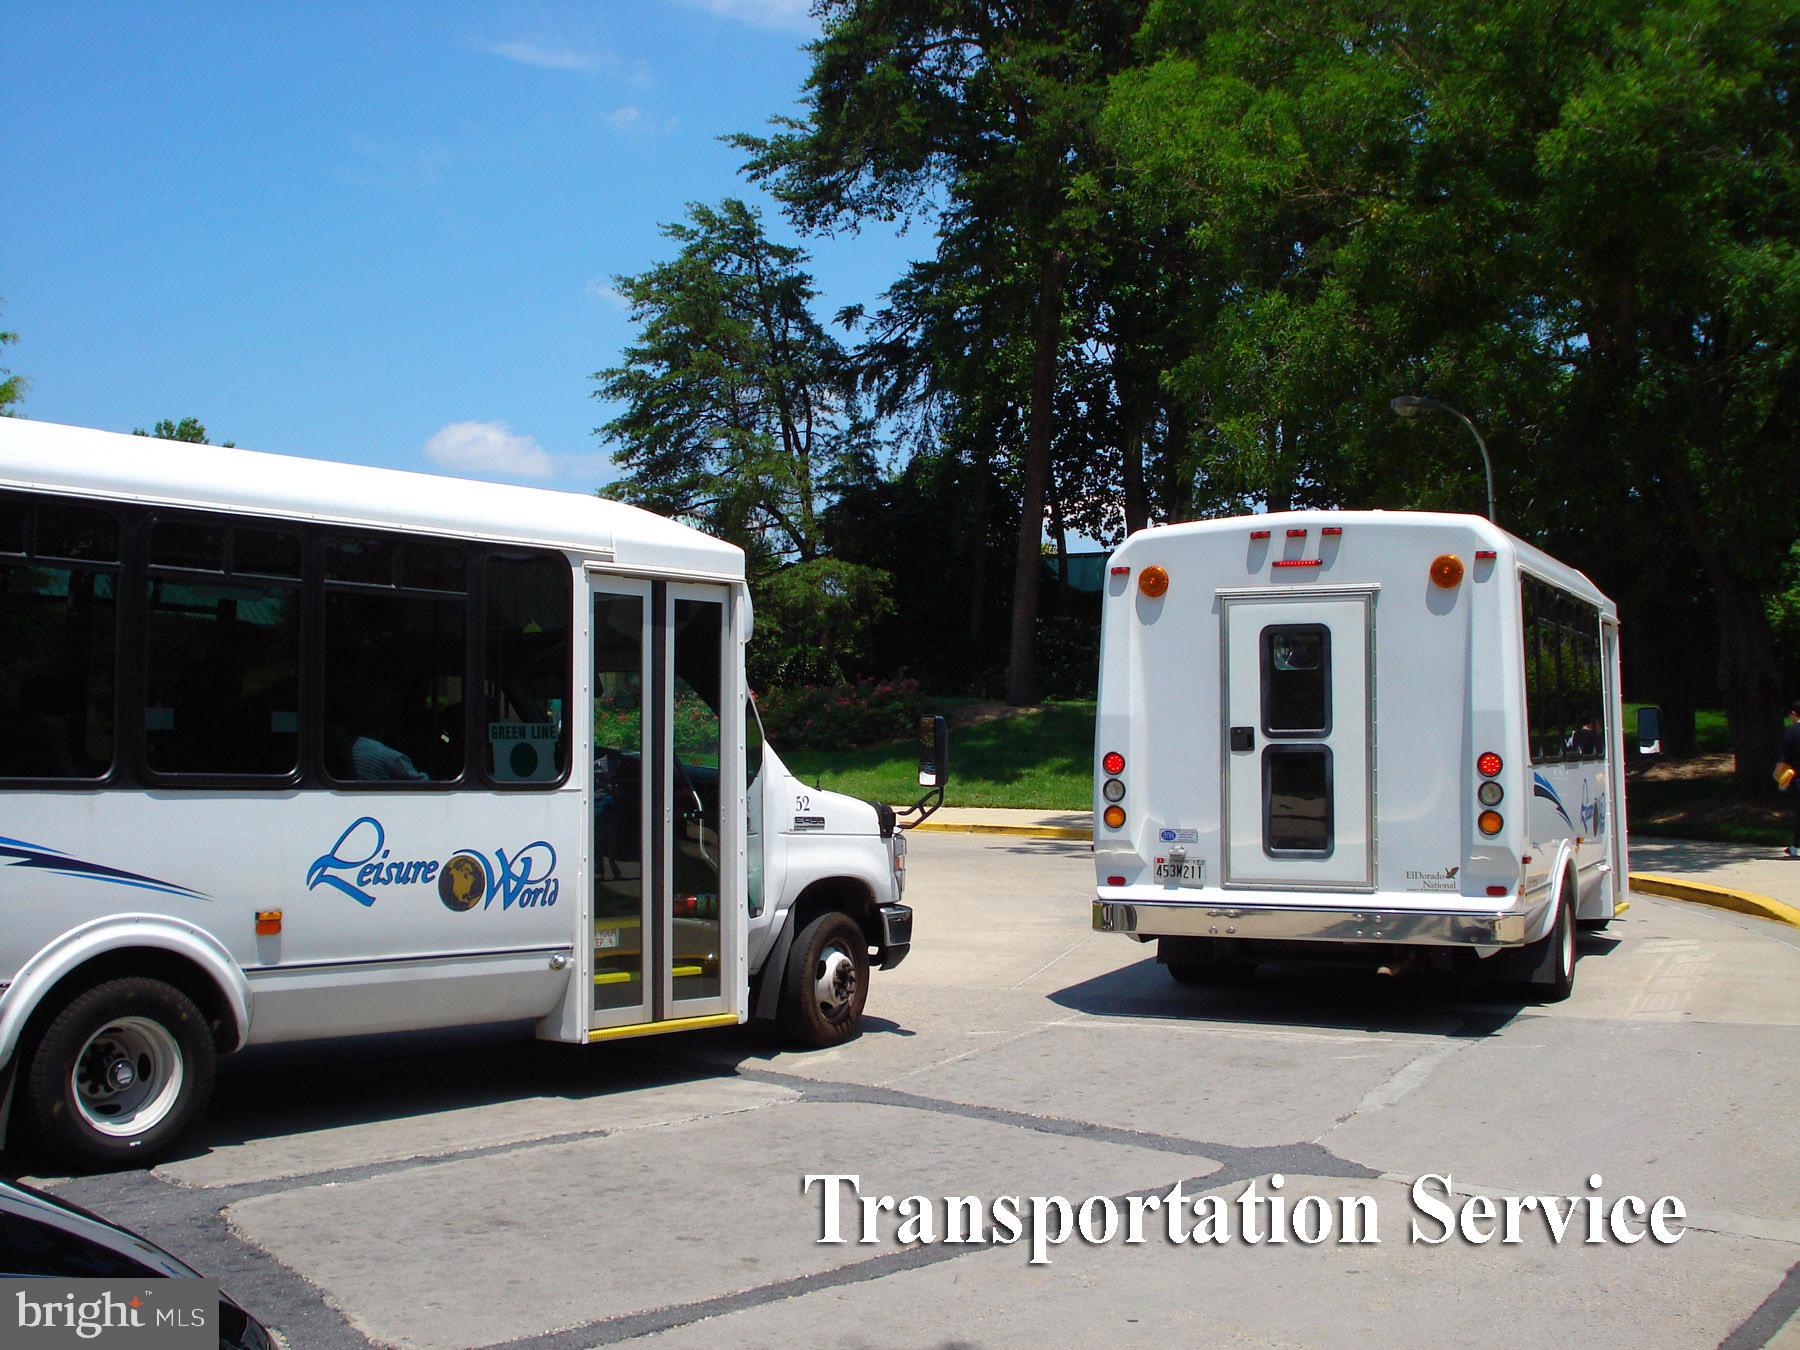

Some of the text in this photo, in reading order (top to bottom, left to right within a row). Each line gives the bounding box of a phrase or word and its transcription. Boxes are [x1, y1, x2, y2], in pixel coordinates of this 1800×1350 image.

[491, 725, 557, 739] GREEN LINE
[796, 795, 810, 812] 52
[306, 816, 560, 912] Leisure World
[1406, 871, 1445, 880] ElDorado
[1422, 880, 1457, 889] National
